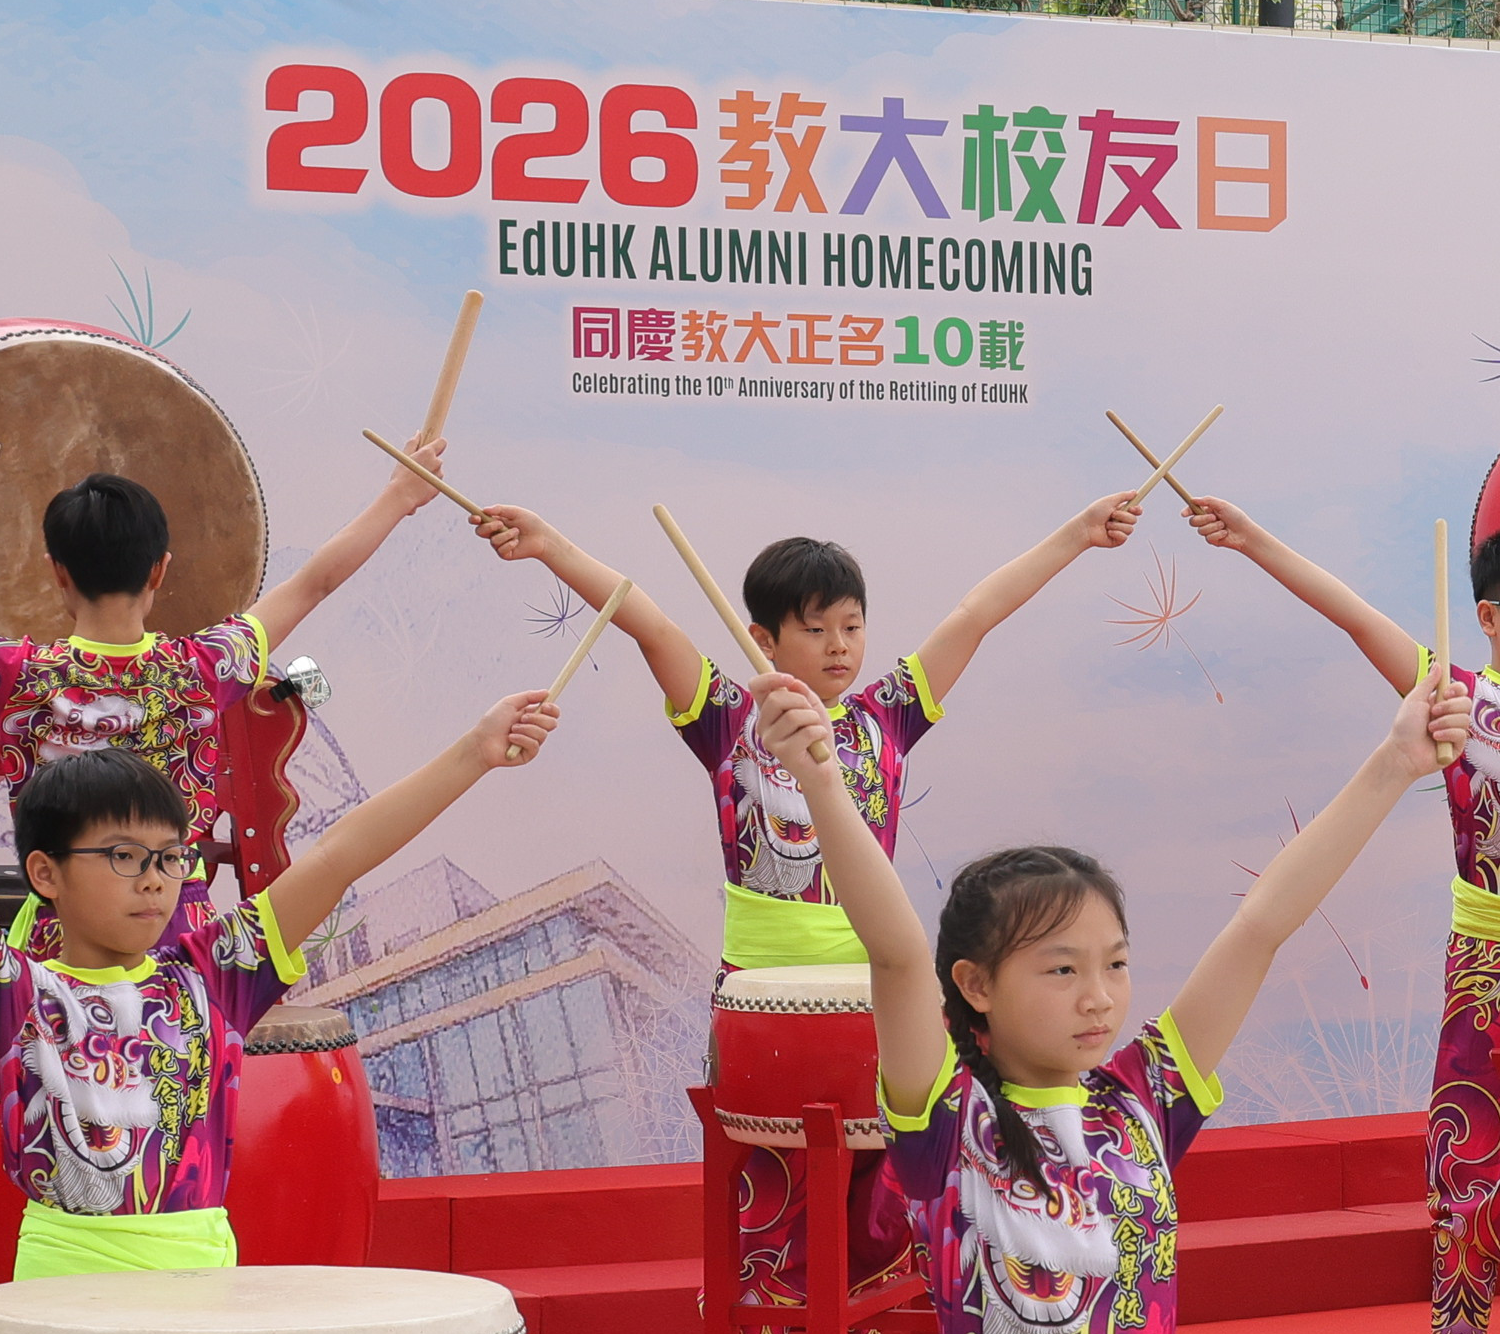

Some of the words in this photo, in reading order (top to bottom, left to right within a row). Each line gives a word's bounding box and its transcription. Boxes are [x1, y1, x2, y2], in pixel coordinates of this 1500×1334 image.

[499, 219, 637, 280] EdUHK
[649, 225, 807, 286] ALUMNI
[823, 232, 1093, 296] HOMECOMING
[572, 372, 670, 398] Celebrating
[674, 375, 702, 396] the
[738, 376, 835, 402] Anniversary
[839, 379, 855, 400] of
[858, 379, 885, 401] the
[889, 380, 957, 405] Retitling
[961, 382, 977, 403] of
[981, 383, 1028, 404] EdUHK
[1111, 1185, 1146, 1328] 紀念學校
